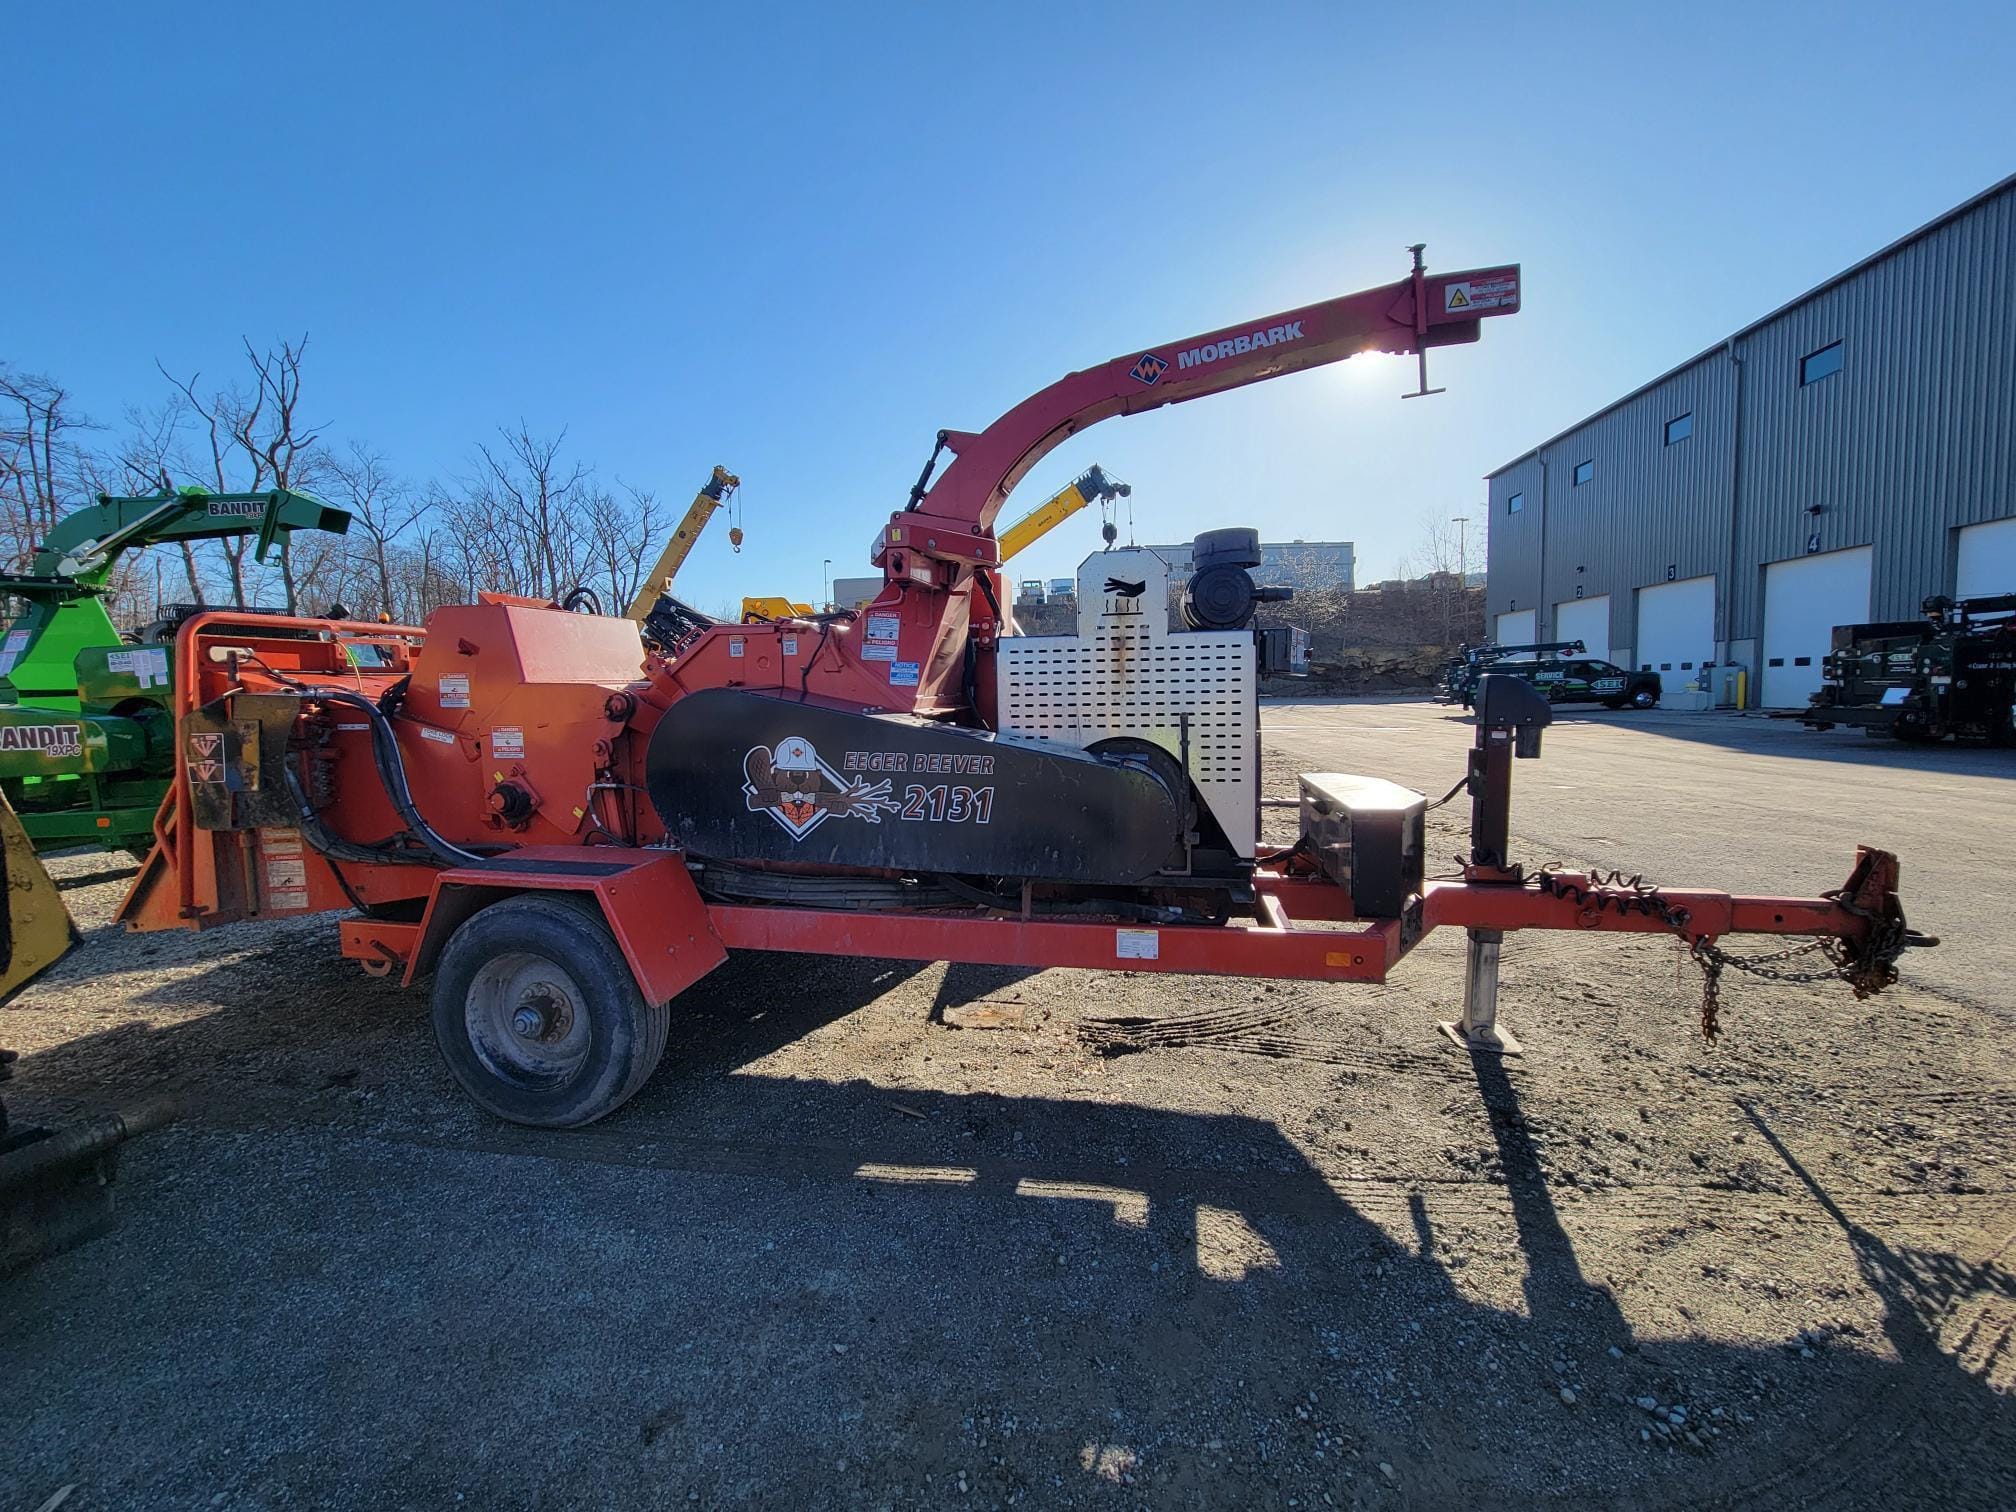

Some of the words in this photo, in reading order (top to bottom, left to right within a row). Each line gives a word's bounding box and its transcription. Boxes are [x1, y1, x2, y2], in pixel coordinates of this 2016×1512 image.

[1177, 320, 1304, 370] MORBARK
[208, 502, 267, 515] BANDIT
[1809, 536, 1818, 551] 4
[1669, 567, 1675, 579] 3
[1577, 587, 1583, 597] 2
[1535, 671, 1564, 680] SERVICE
[0, 726, 79, 750] ANDIT
[46, 745, 81, 756] 19XPC
[843, 751, 909, 772] EEGER
[912, 753, 995, 775] BEEVER
[900, 784, 995, 824] 2131
